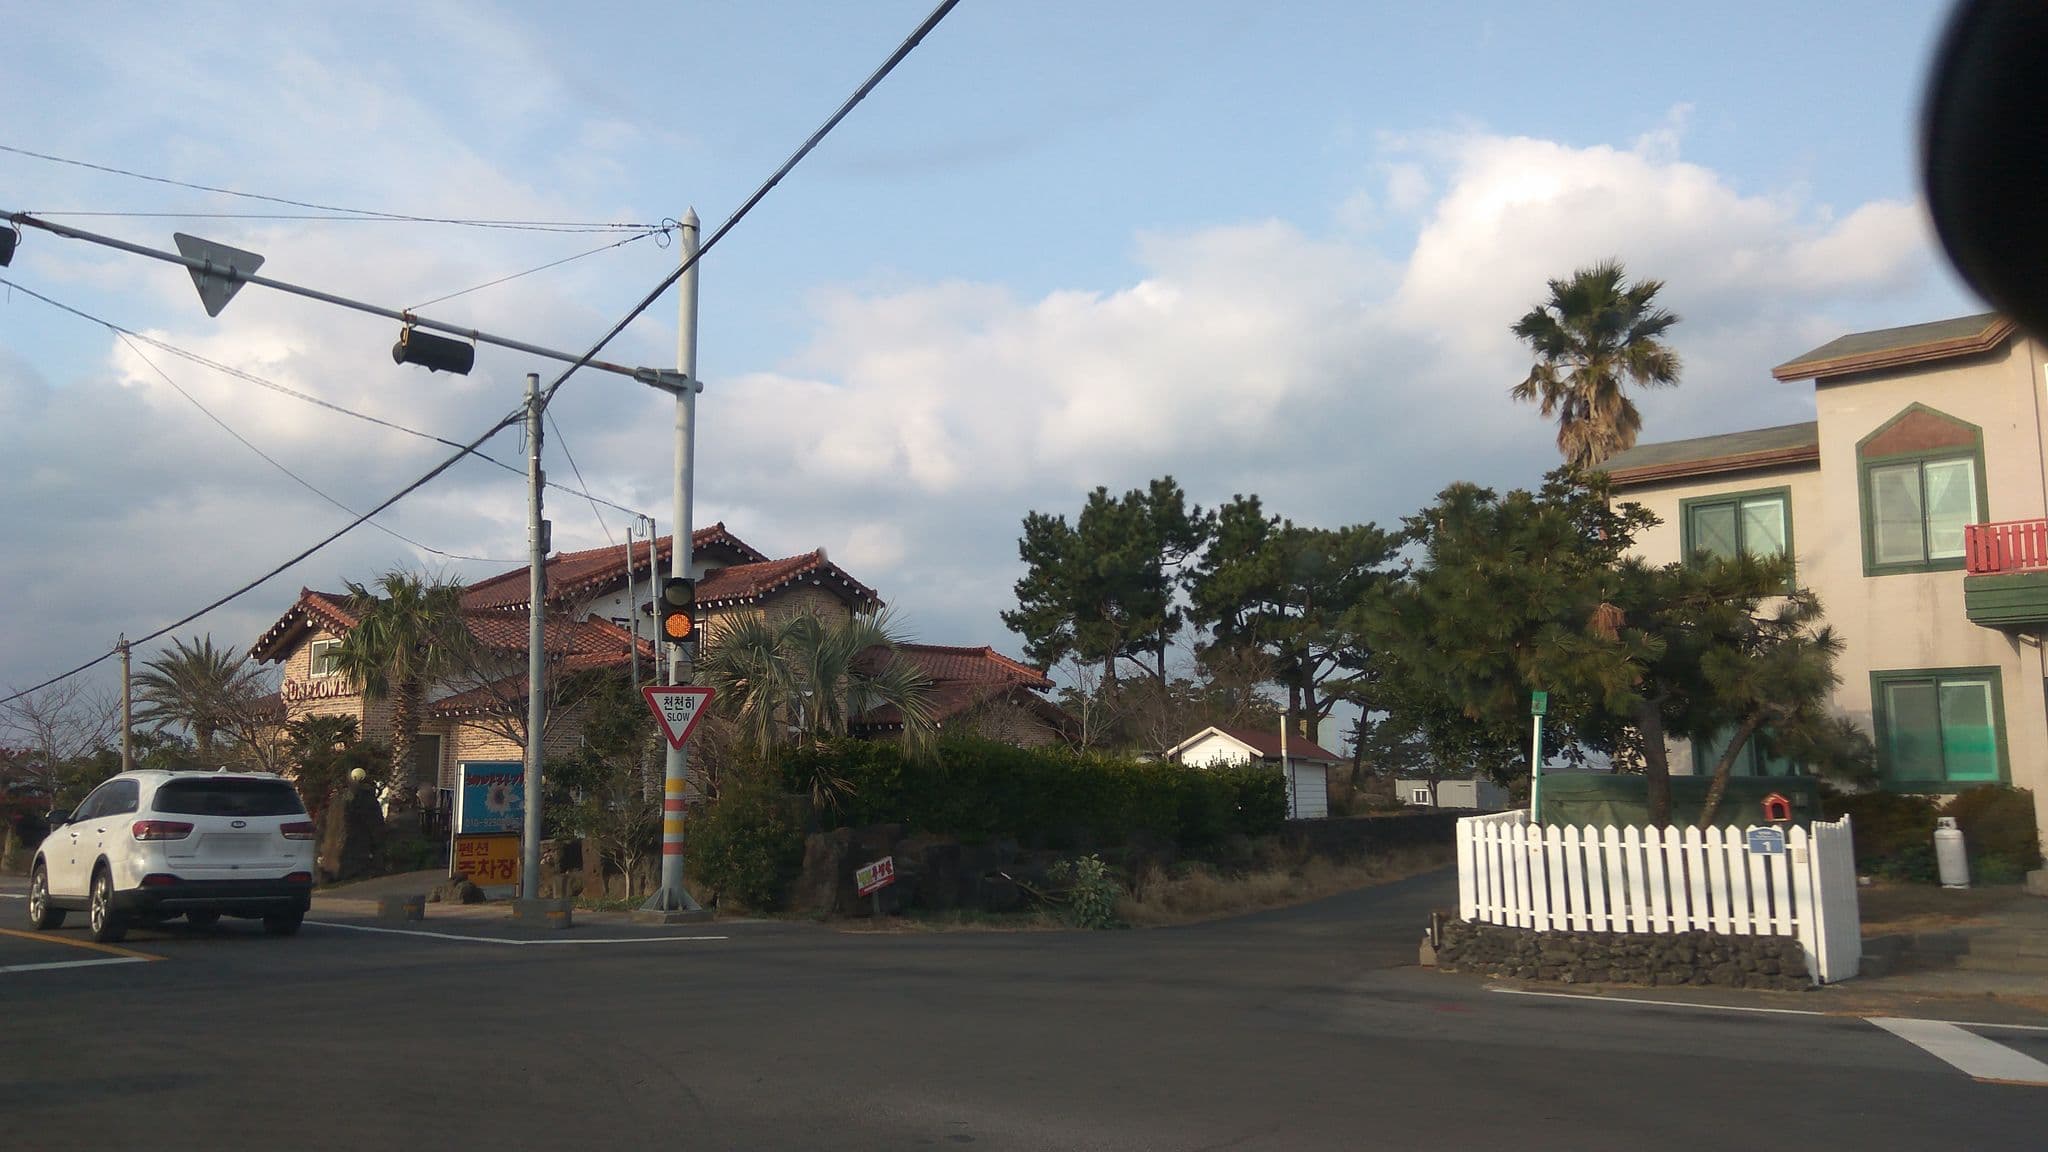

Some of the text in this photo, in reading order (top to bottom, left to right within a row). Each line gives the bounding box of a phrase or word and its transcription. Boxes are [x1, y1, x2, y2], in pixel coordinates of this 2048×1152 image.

[663, 696, 695, 710] 천천히
[667, 712, 690, 722] SLOW
[458, 841, 489, 857] 펜션
[458, 857, 516, 880] 주차장
